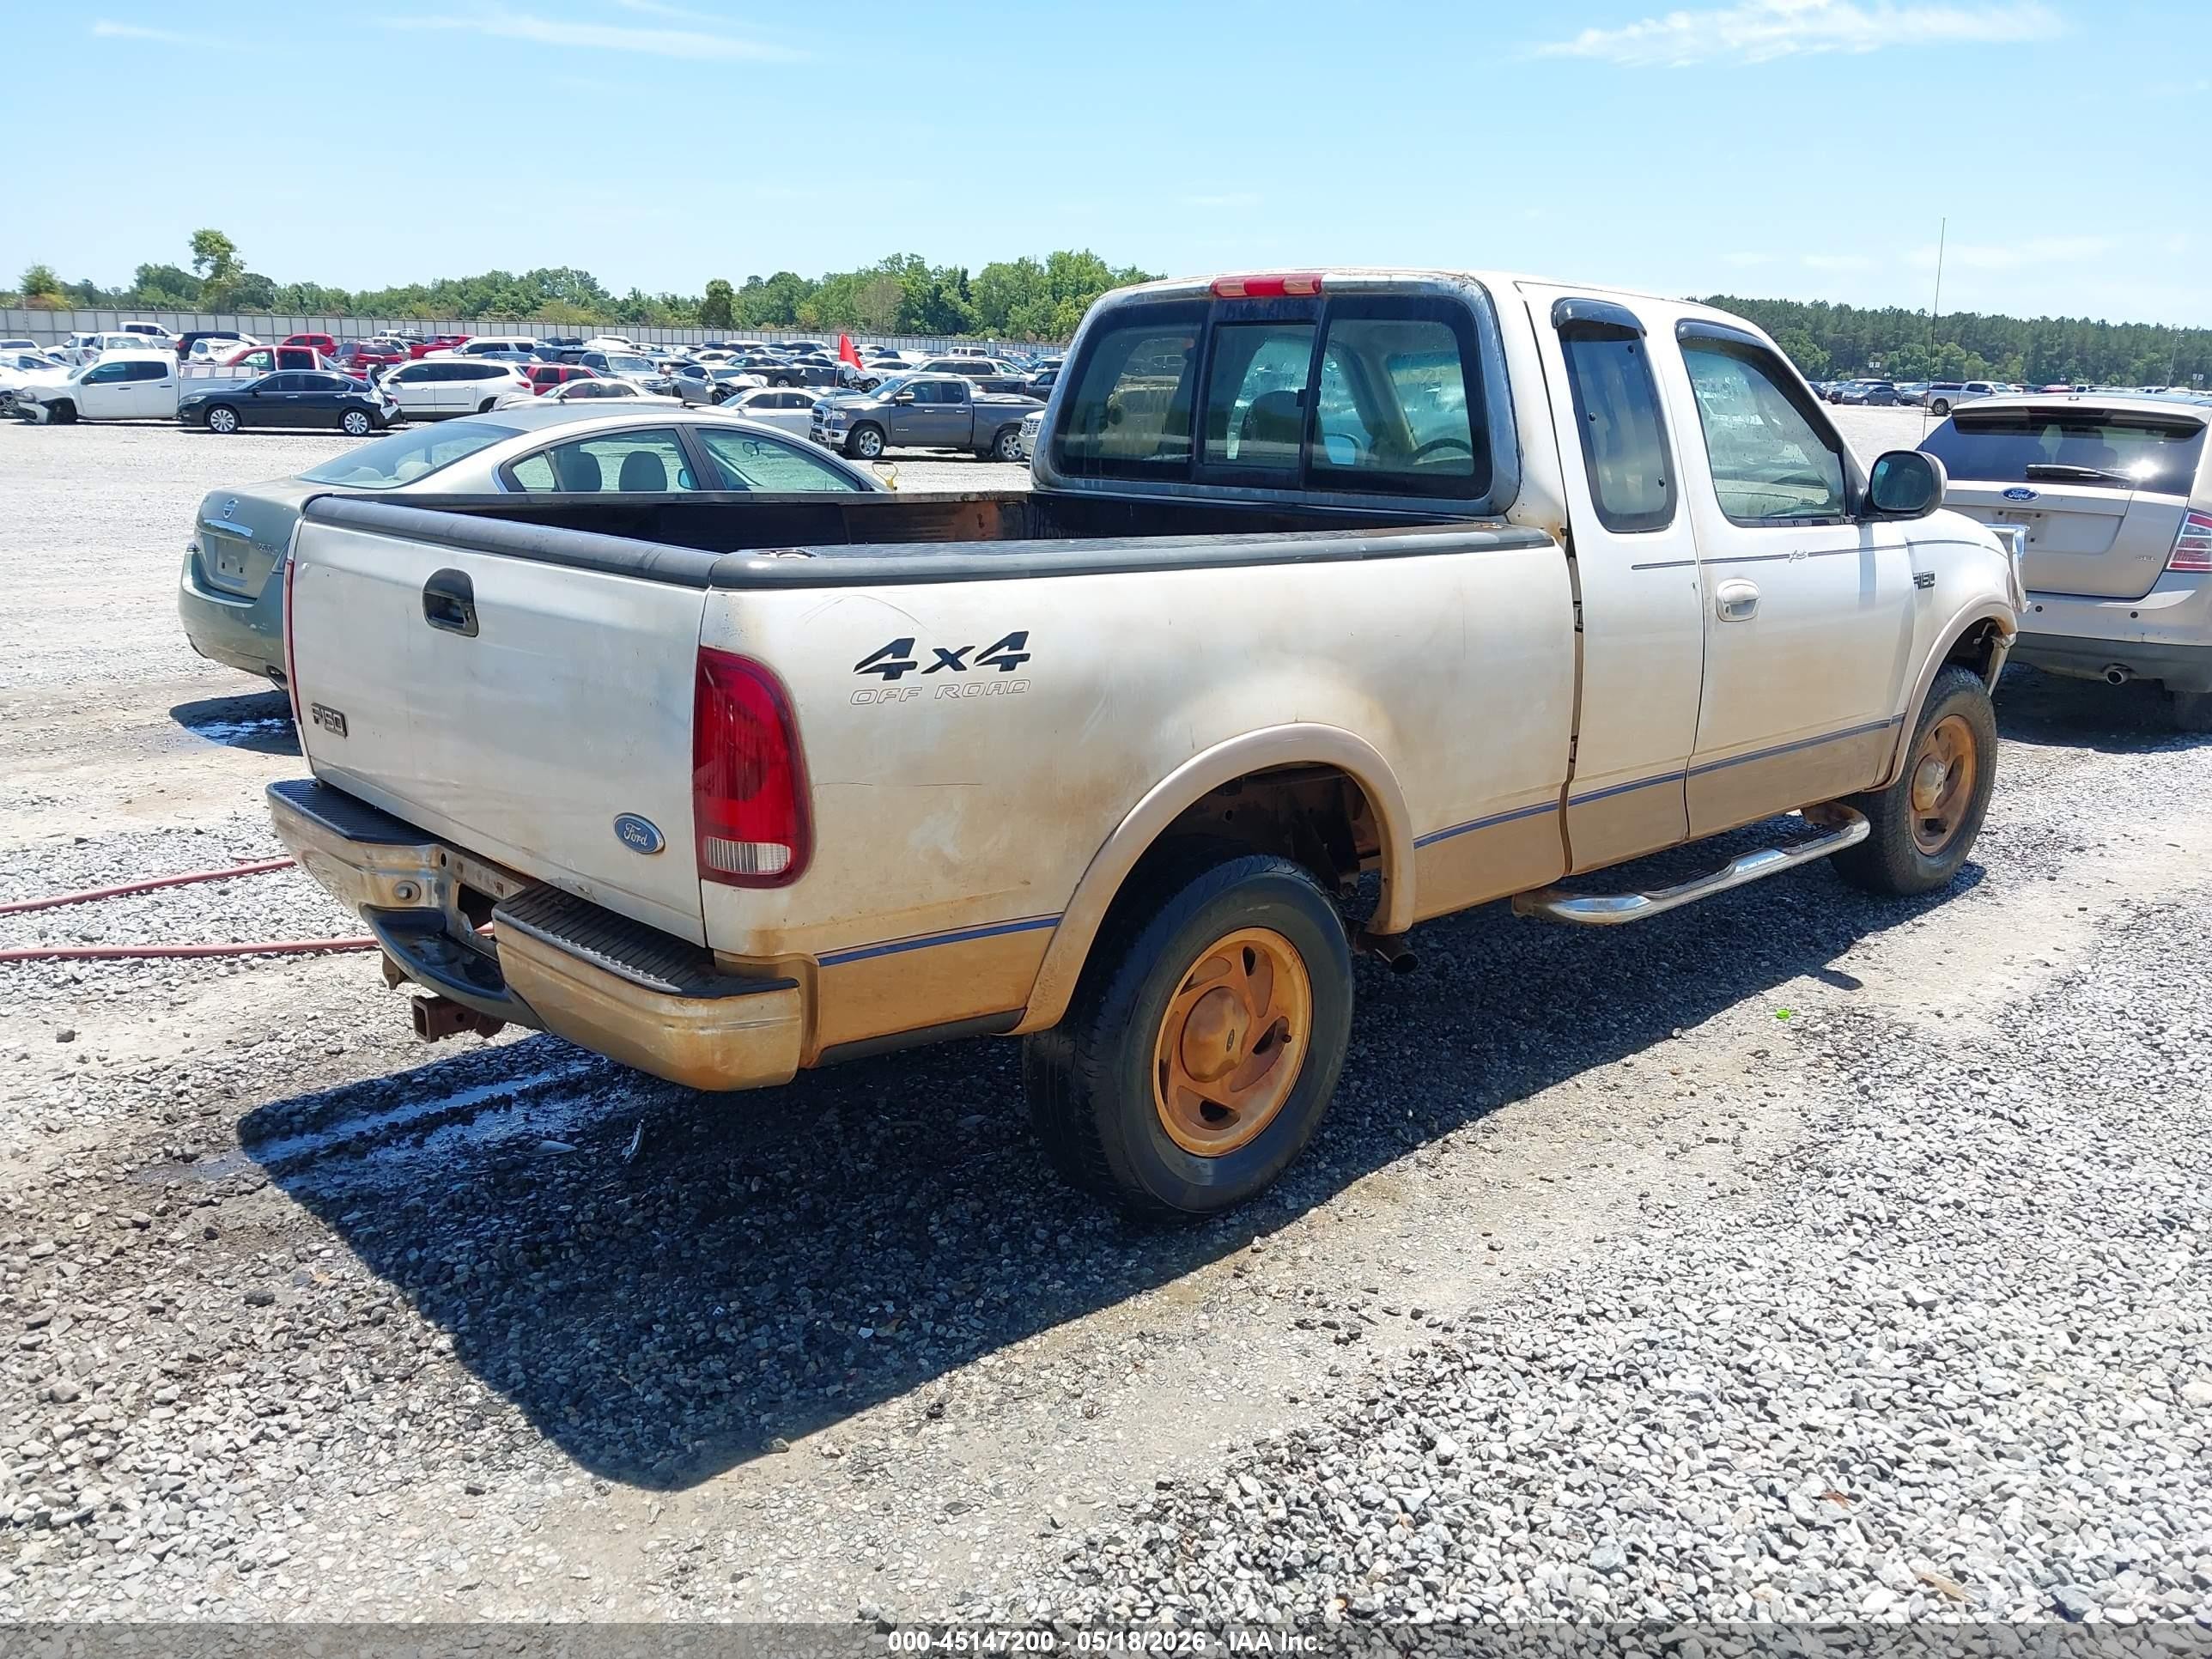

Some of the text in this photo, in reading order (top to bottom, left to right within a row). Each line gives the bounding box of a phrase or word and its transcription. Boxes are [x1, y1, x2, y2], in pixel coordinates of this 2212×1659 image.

[2008, 489, 2031, 499] Ford
[850, 679, 1031, 705] OFF ROAD
[624, 823, 648, 847] Ford
